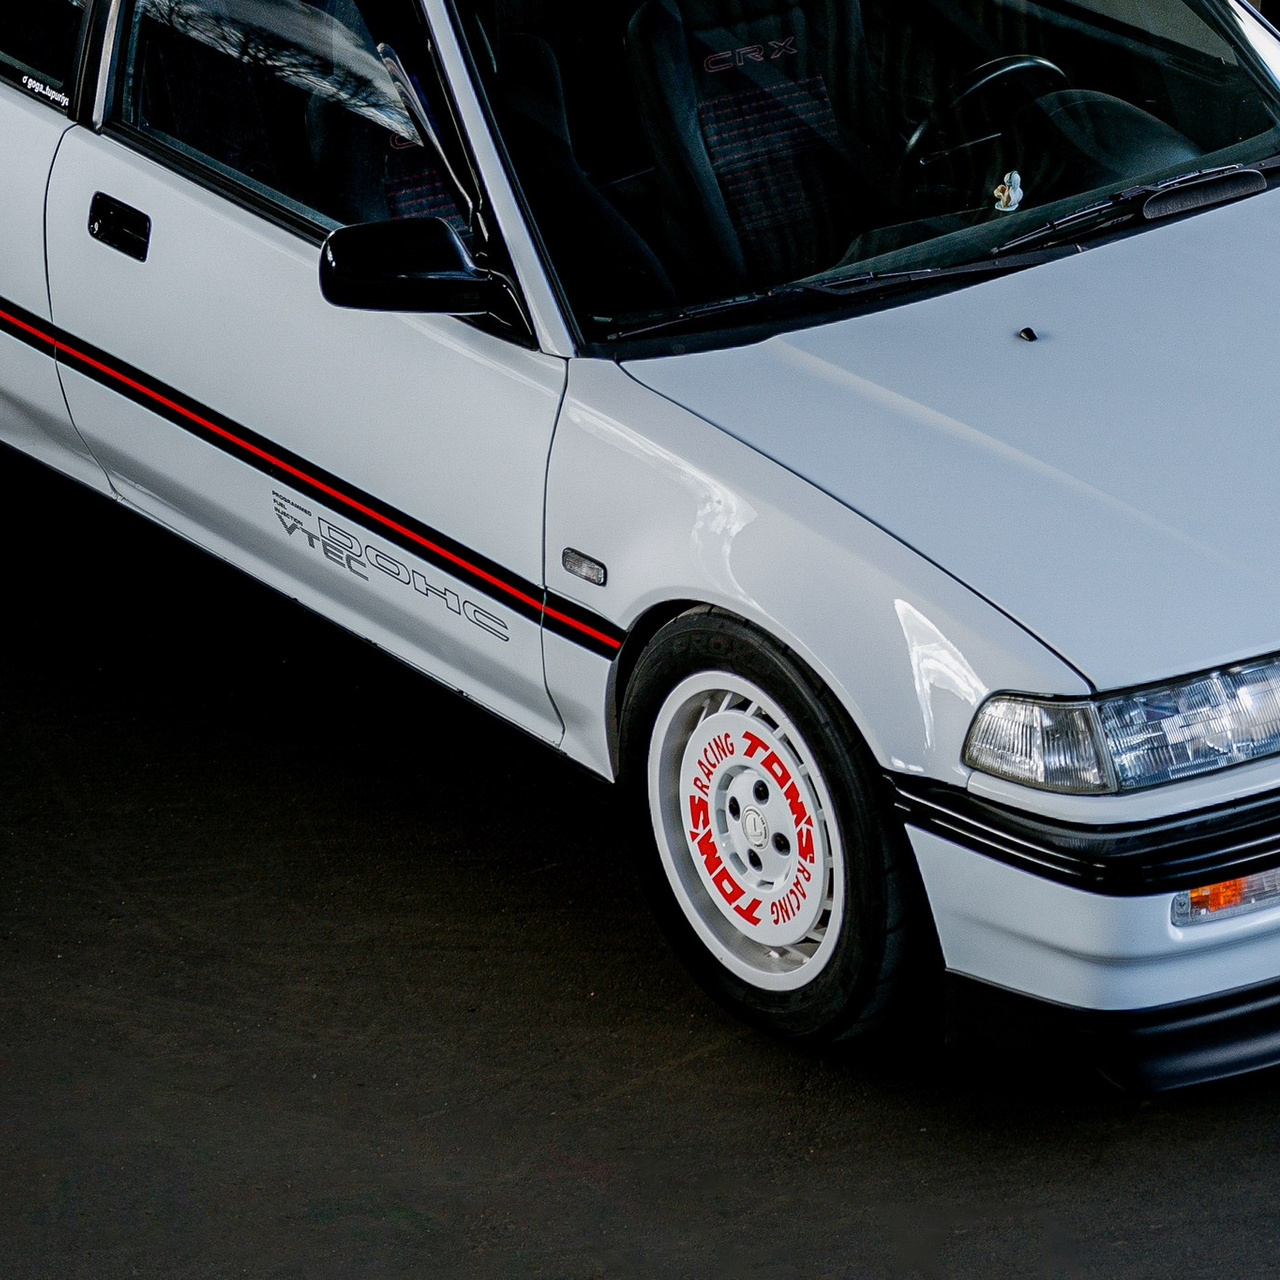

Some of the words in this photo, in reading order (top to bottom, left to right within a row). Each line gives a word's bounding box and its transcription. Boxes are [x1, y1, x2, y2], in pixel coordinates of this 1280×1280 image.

[704, 36, 798, 73] CRX
[271, 490, 312, 517] PROGRAMMED
[273, 498, 287, 510] FUEL
[274, 506, 303, 526] INJECTION
[275, 512, 370, 582] VTEC
[317, 516, 510, 642] DOHC
[692, 732, 735, 797] RACING
[742, 730, 816, 864] TOM'S
[688, 794, 762, 926] TOM'S
[770, 862, 812, 926] RACING
